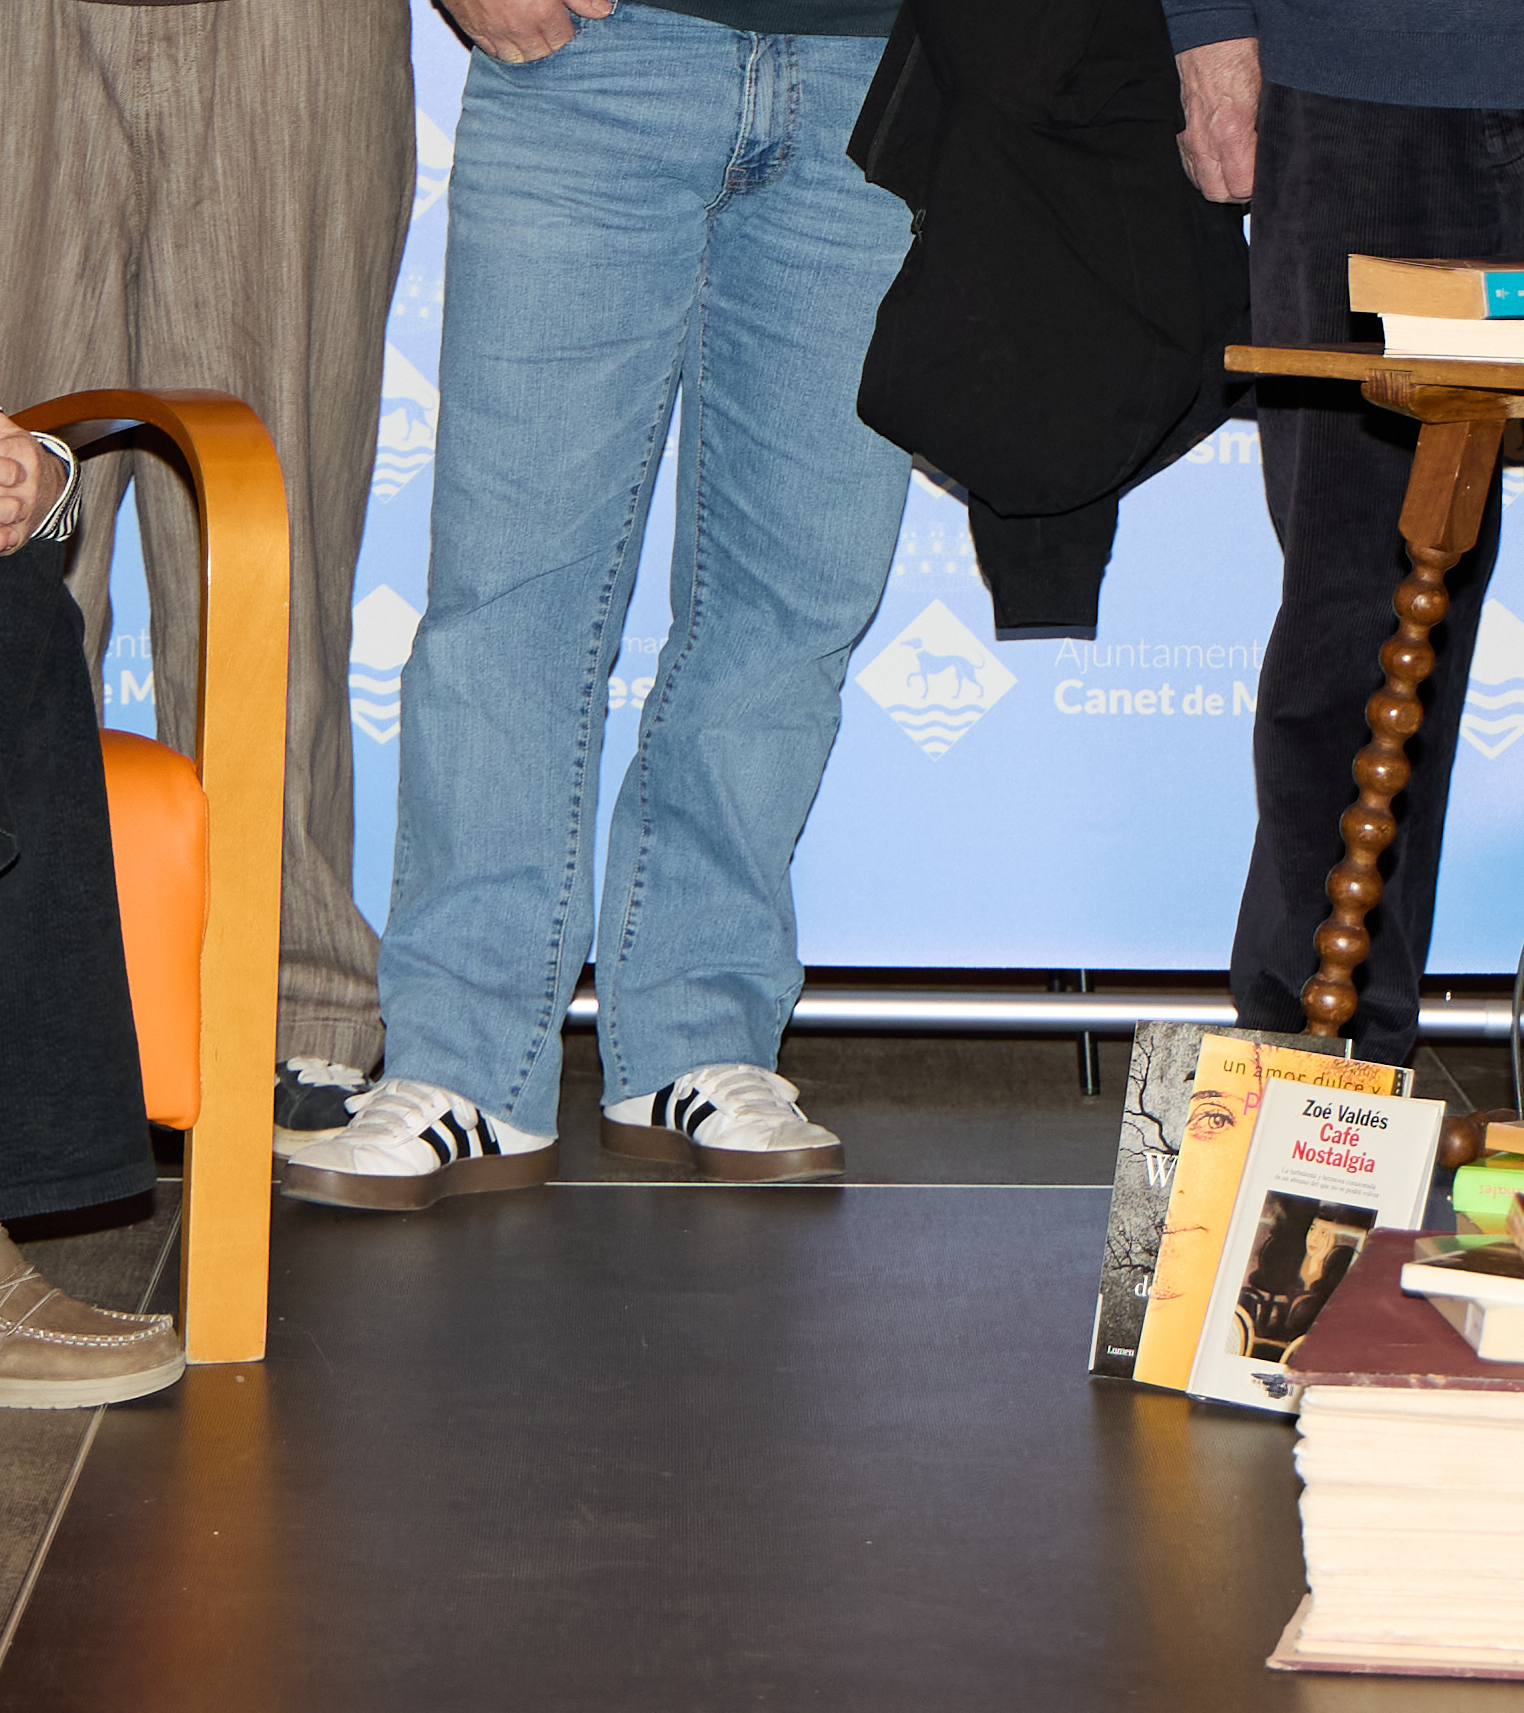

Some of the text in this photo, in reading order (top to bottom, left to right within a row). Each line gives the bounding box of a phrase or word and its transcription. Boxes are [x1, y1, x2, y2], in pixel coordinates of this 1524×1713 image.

[1053, 637, 1265, 675] Ajuntament
[1053, 678, 1175, 715] Canet
[1181, 684, 1226, 716] de
[1302, 1098, 1389, 1130] Zoé Valdés
[1320, 1122, 1361, 1147] Café
[1291, 1140, 1376, 1174] Nostalgia
